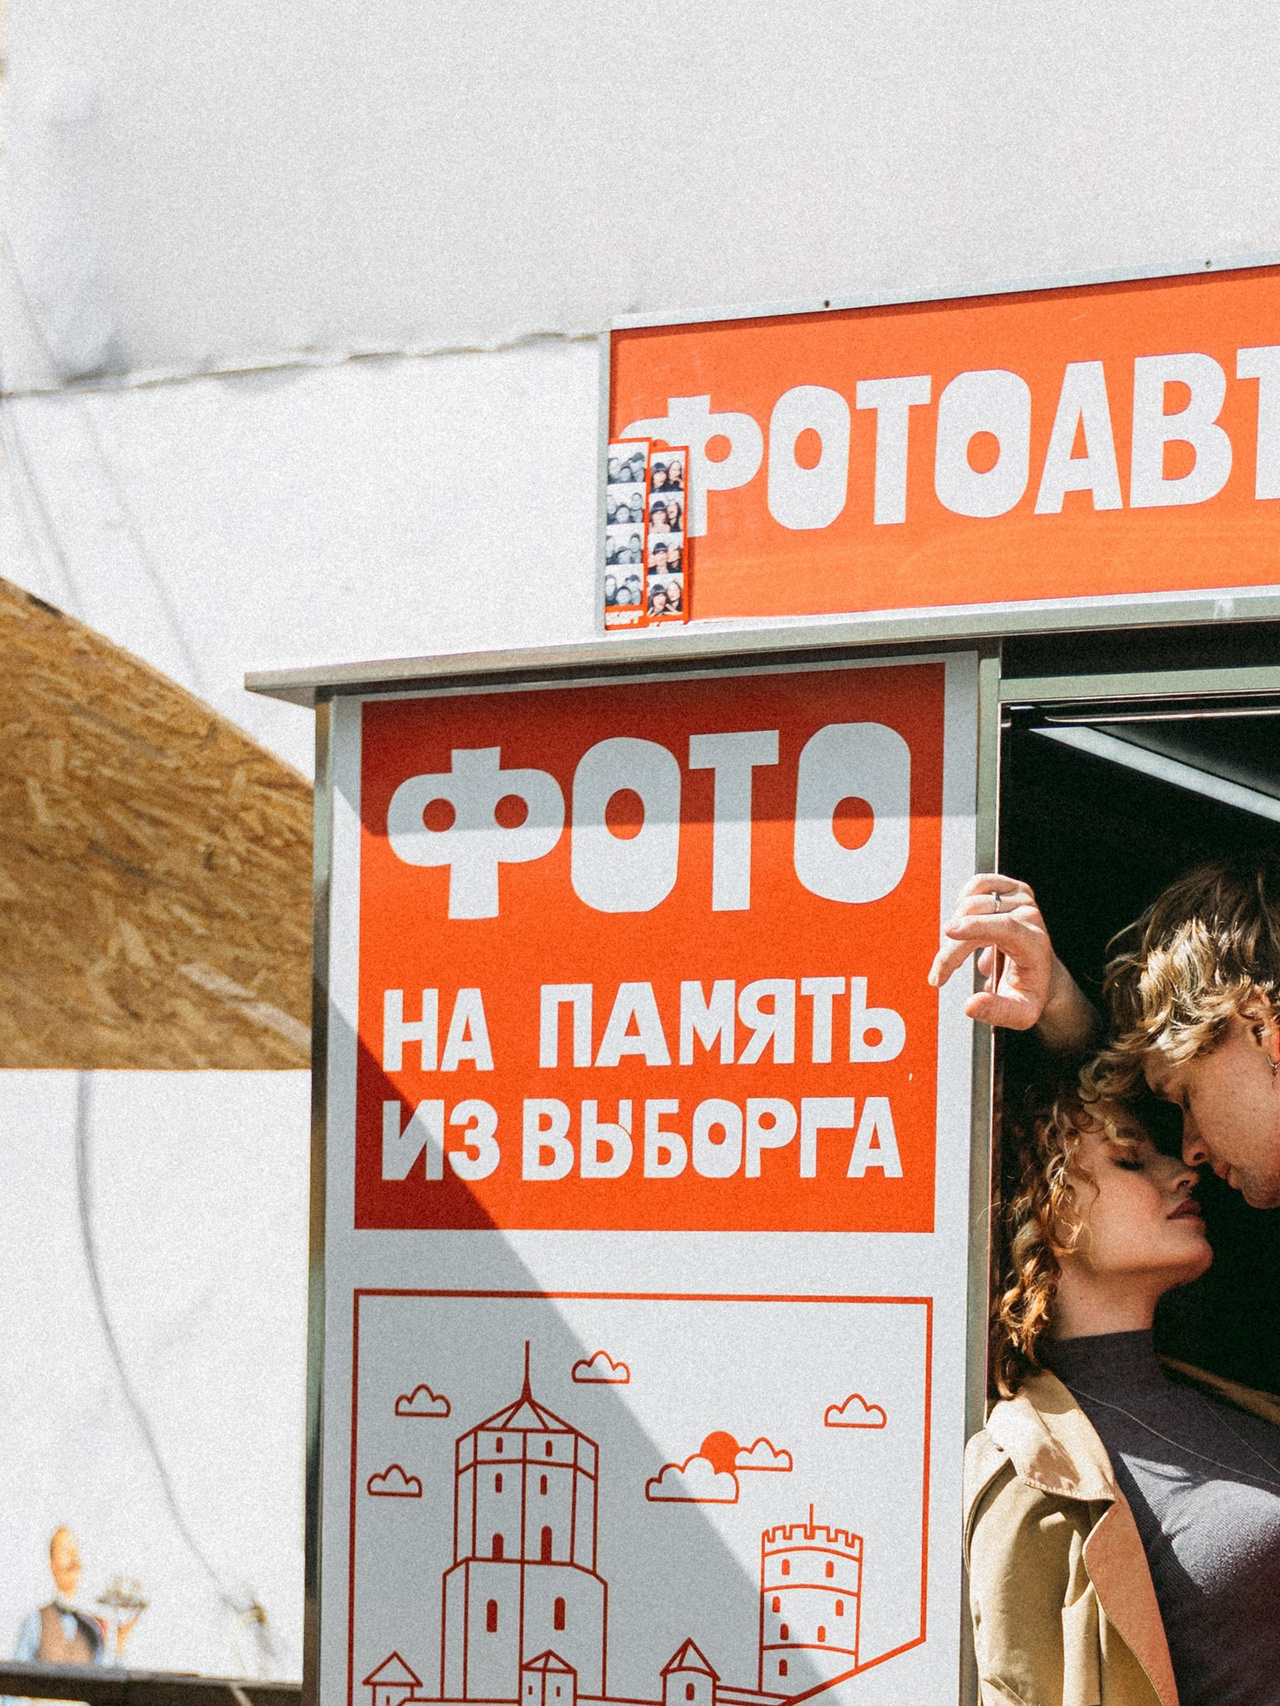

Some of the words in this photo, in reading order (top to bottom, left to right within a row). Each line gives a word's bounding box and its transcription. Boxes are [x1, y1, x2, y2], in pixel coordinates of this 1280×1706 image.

[386, 722, 911, 920] ФОТО
[382, 988, 494, 1072] НА
[539, 976, 906, 1069] ПАМЯТЬ
[381, 1099, 500, 1181] ИЗ
[521, 1096, 904, 1181] ВЫБОРГА
